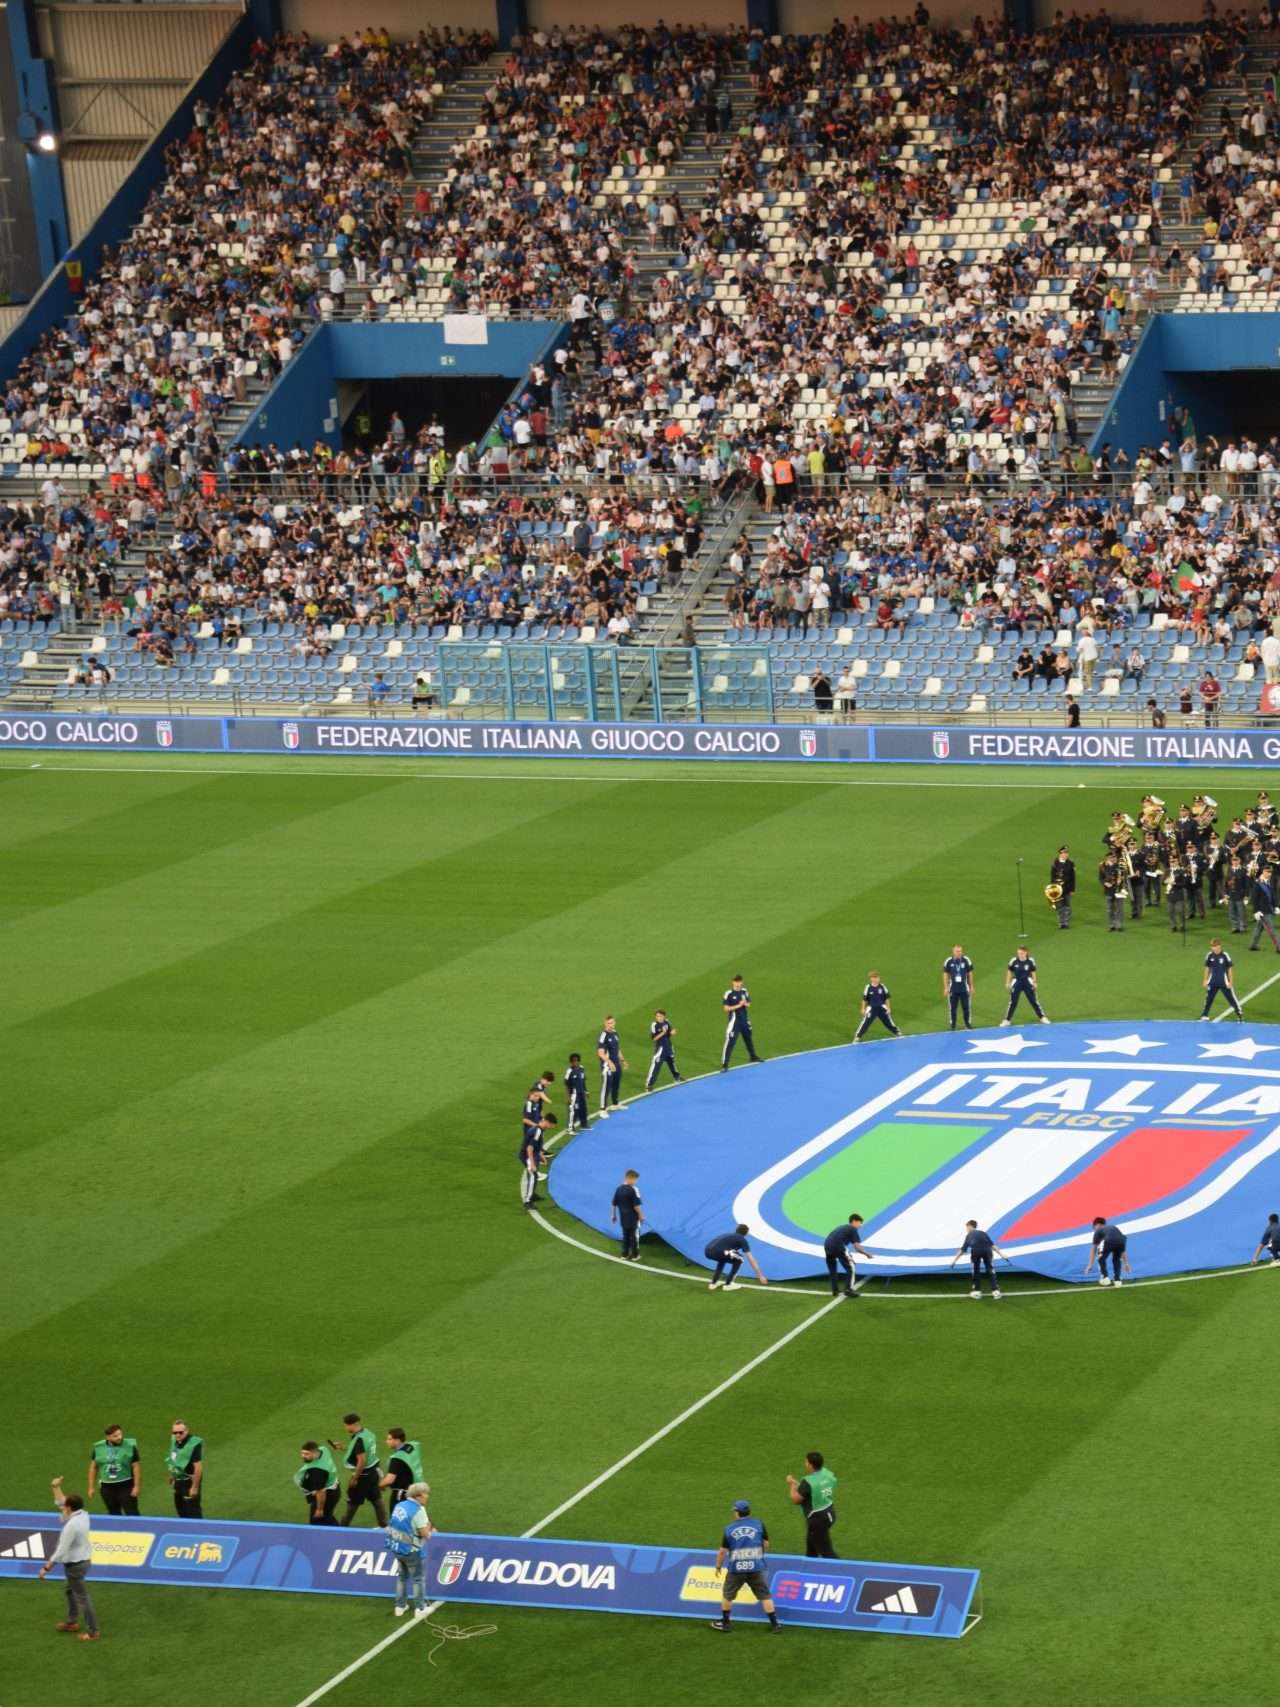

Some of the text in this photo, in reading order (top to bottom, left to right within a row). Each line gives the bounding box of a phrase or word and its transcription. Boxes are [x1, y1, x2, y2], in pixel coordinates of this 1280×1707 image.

[56, 721, 138, 743] CALCIO
[317, 726, 780, 753] FEDERAZIONE ITALIANA GIUOCO CALCIO
[968, 735, 1135, 758] FEDERAZIONE
[1146, 737, 1254, 759] ITALIANA
[1021, 1112, 1136, 1129] FIGC
[165, 1543, 199, 1559] eni
[327, 1549, 616, 1590] ITALI MOLDOVA
[803, 1582, 845, 1604] TIM
